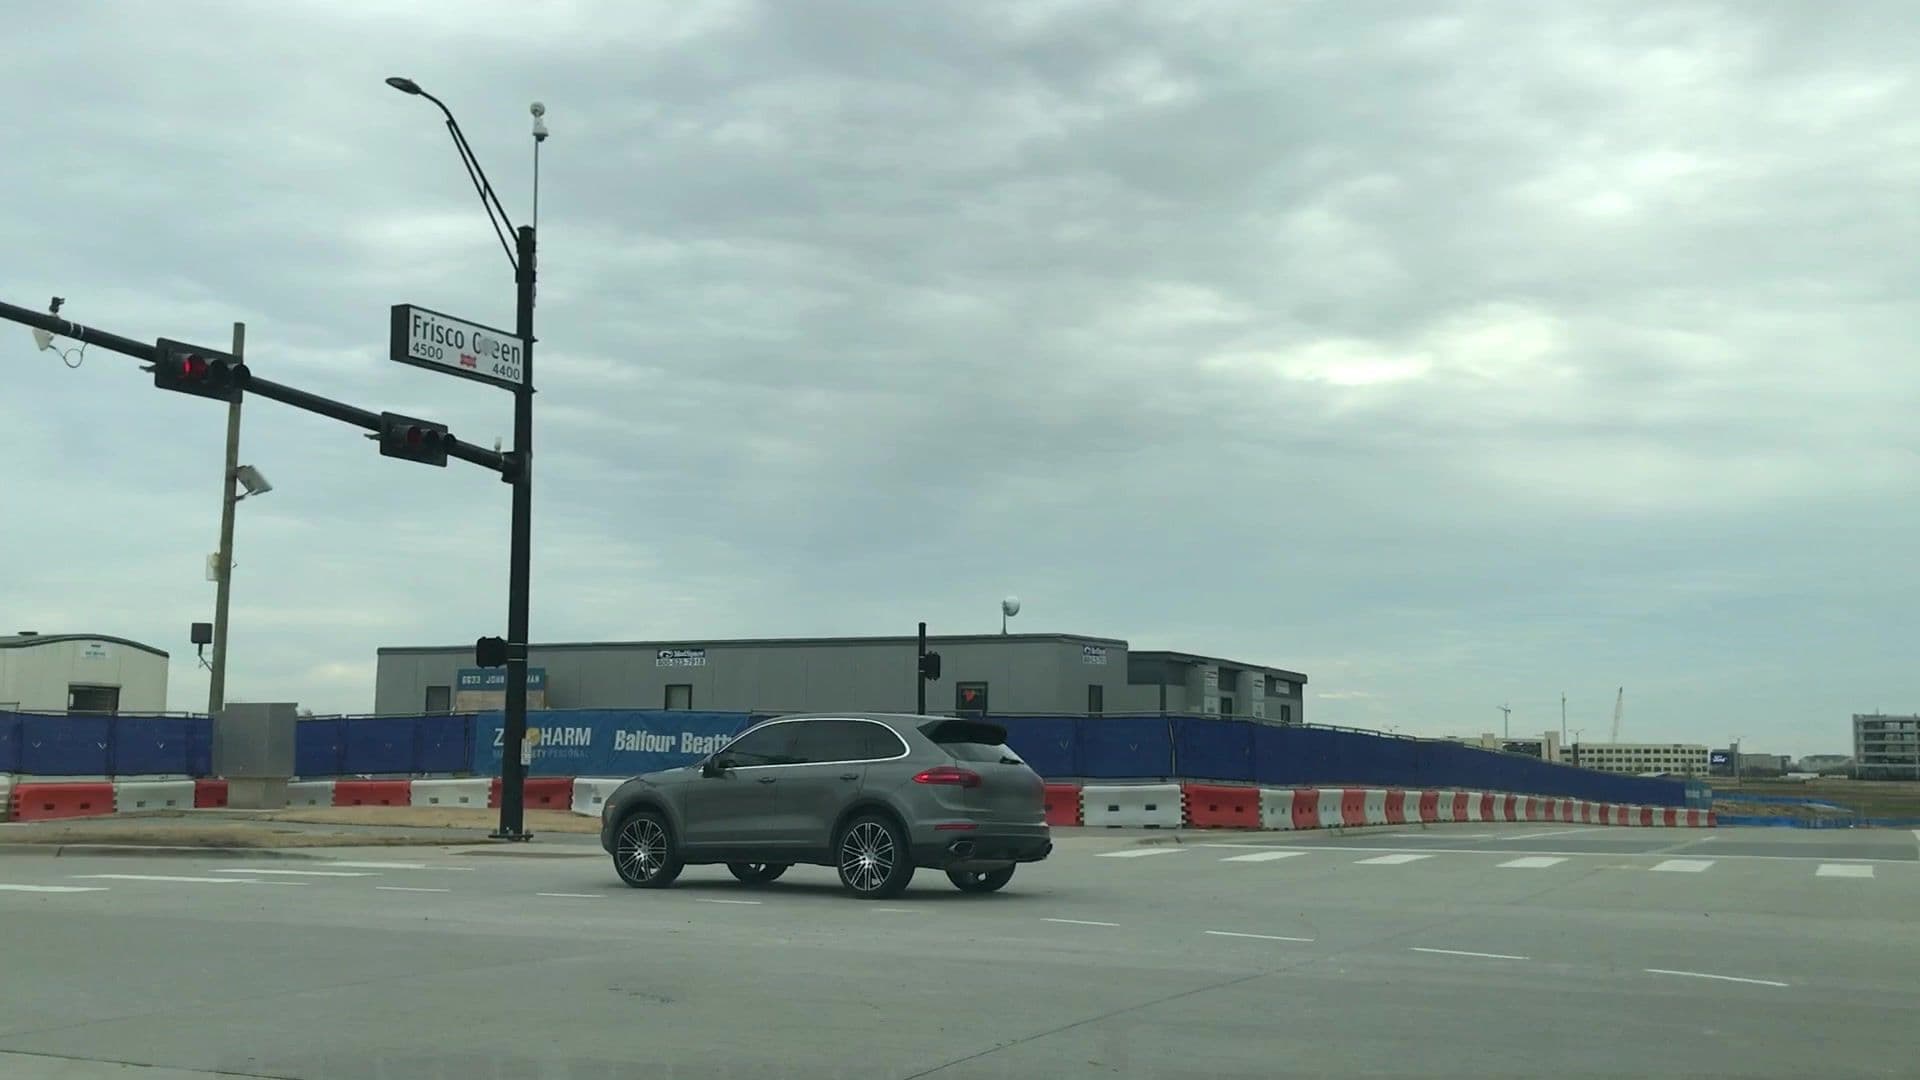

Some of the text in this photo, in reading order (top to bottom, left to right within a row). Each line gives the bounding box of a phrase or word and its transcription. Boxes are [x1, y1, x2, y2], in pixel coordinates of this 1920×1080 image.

[413, 314, 520, 365] Frisco Geen
[412, 342, 443, 360] 4500
[492, 363, 520, 380] 4400
[541, 727, 592, 747] HARM
[614, 730, 677, 753] Balfour
